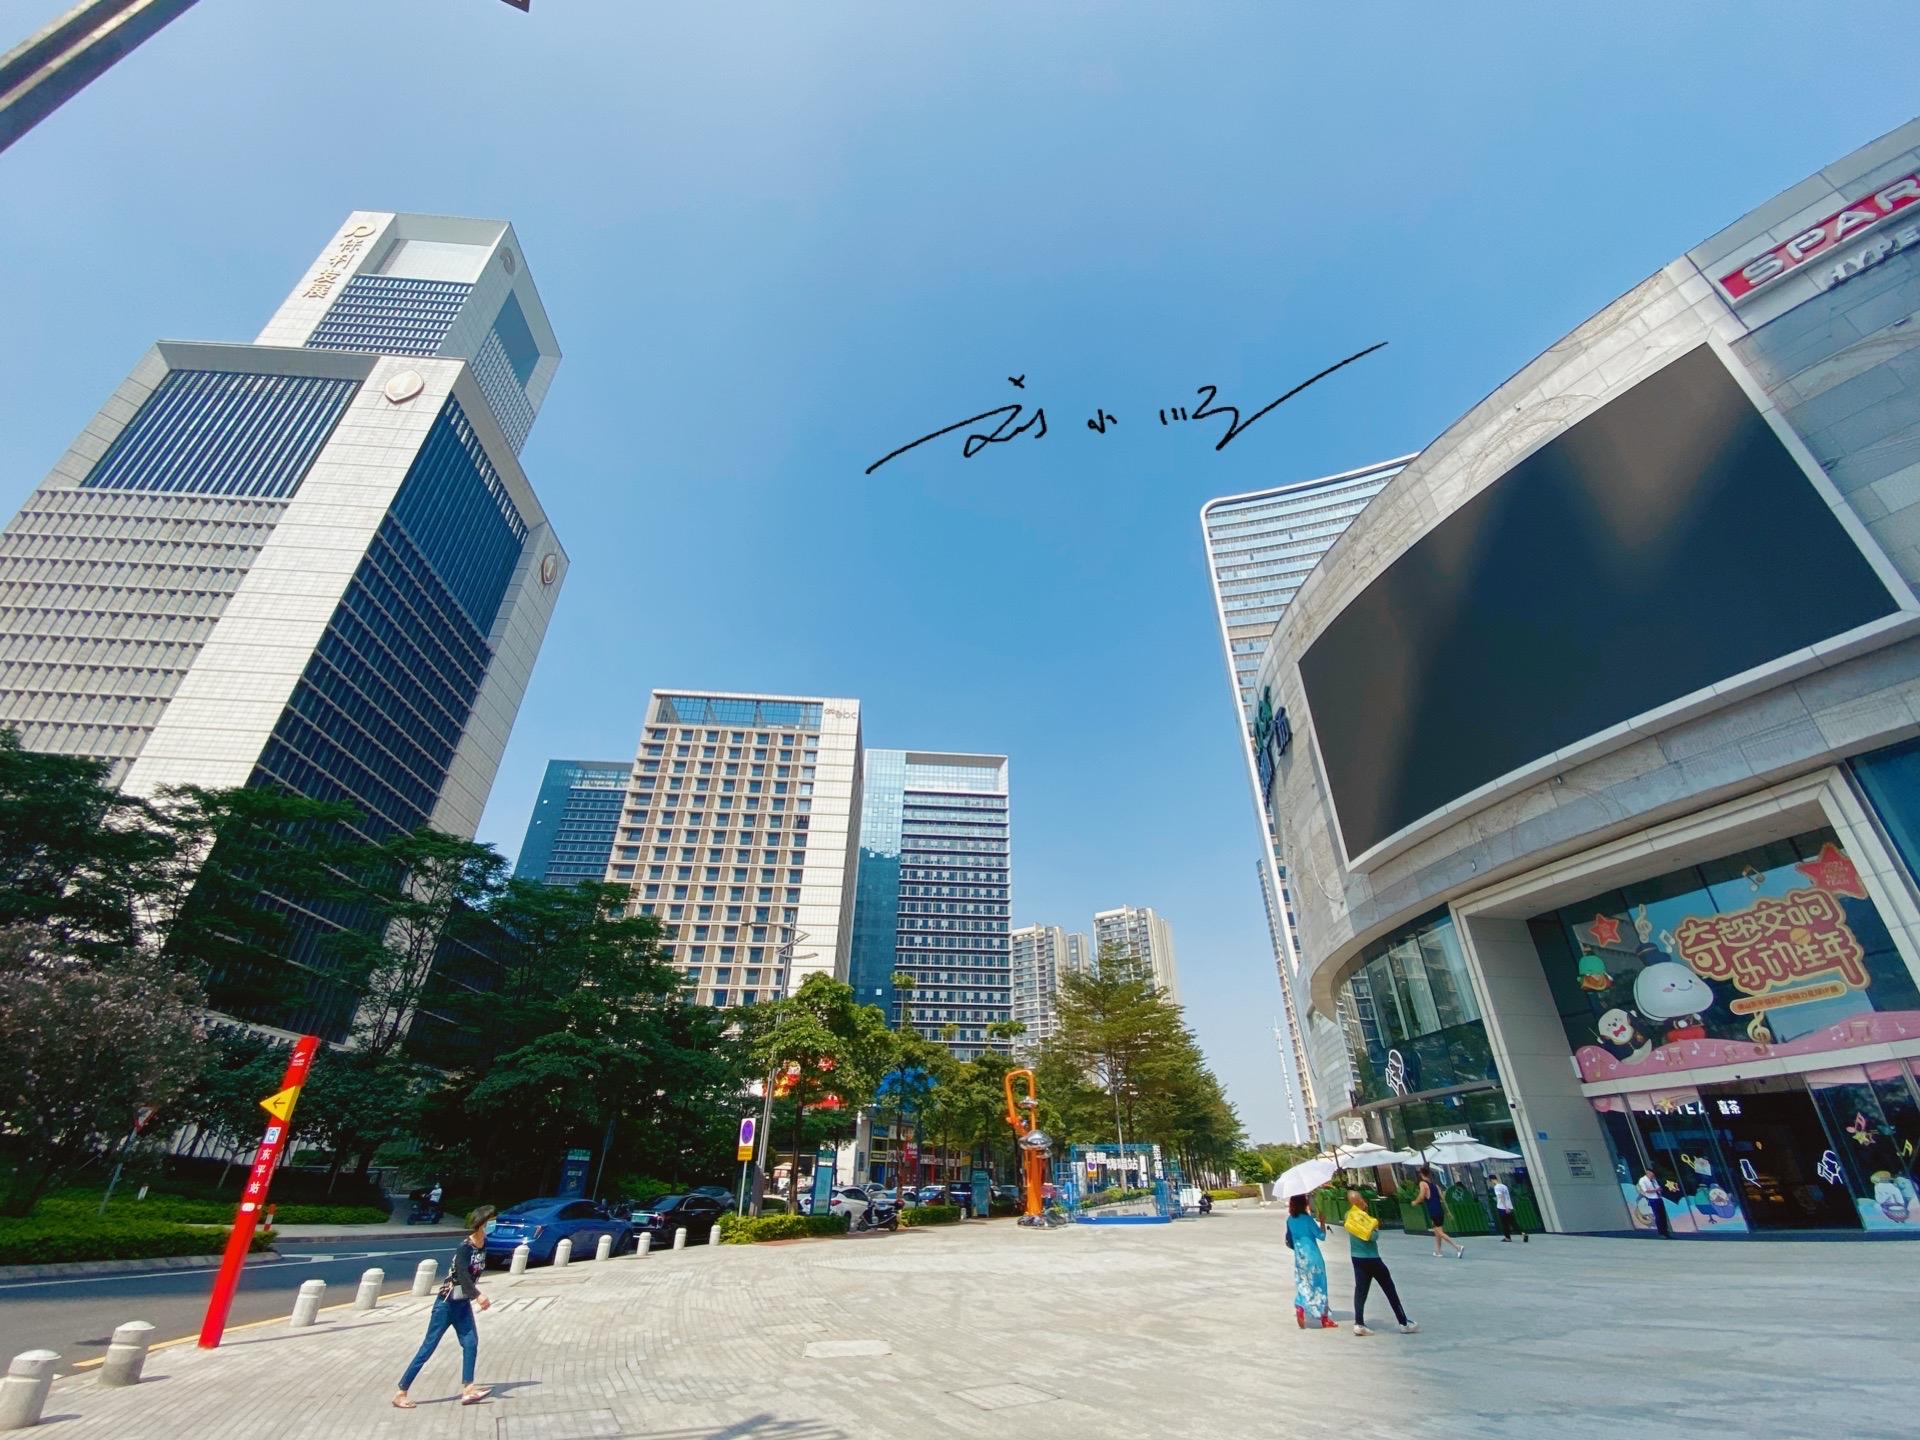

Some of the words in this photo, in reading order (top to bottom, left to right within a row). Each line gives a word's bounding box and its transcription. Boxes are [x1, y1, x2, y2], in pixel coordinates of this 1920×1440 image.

[1742, 178, 1920, 287] SPAR
[1681, 893, 1834, 972] 奇趣交响
[1717, 1099, 1741, 1115] 喜茶
[248, 1148, 272, 1195] 东平站
